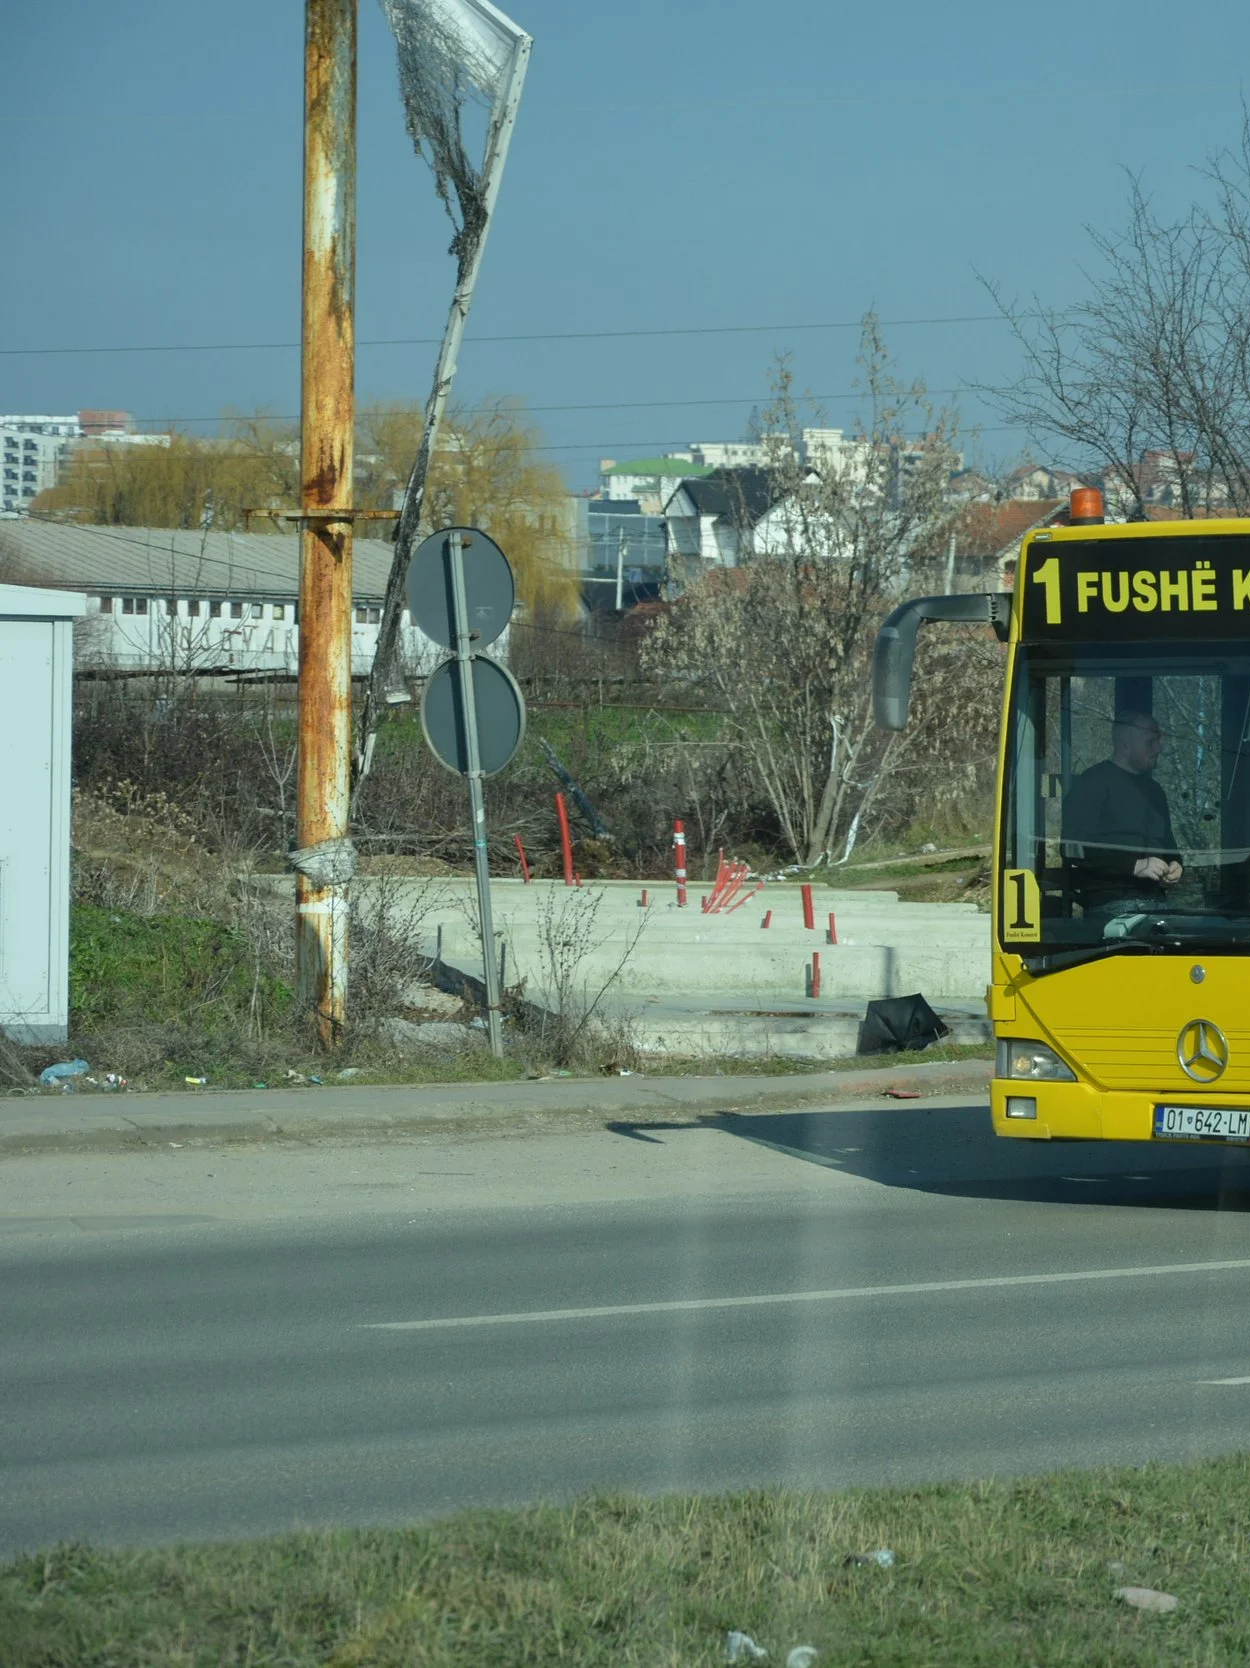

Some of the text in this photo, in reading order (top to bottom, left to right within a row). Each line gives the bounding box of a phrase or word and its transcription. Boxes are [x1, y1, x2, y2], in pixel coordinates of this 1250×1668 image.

[1033, 558, 1062, 625] 1
[1077, 560, 1218, 613] FUSHË
[1009, 872, 1034, 928] 1
